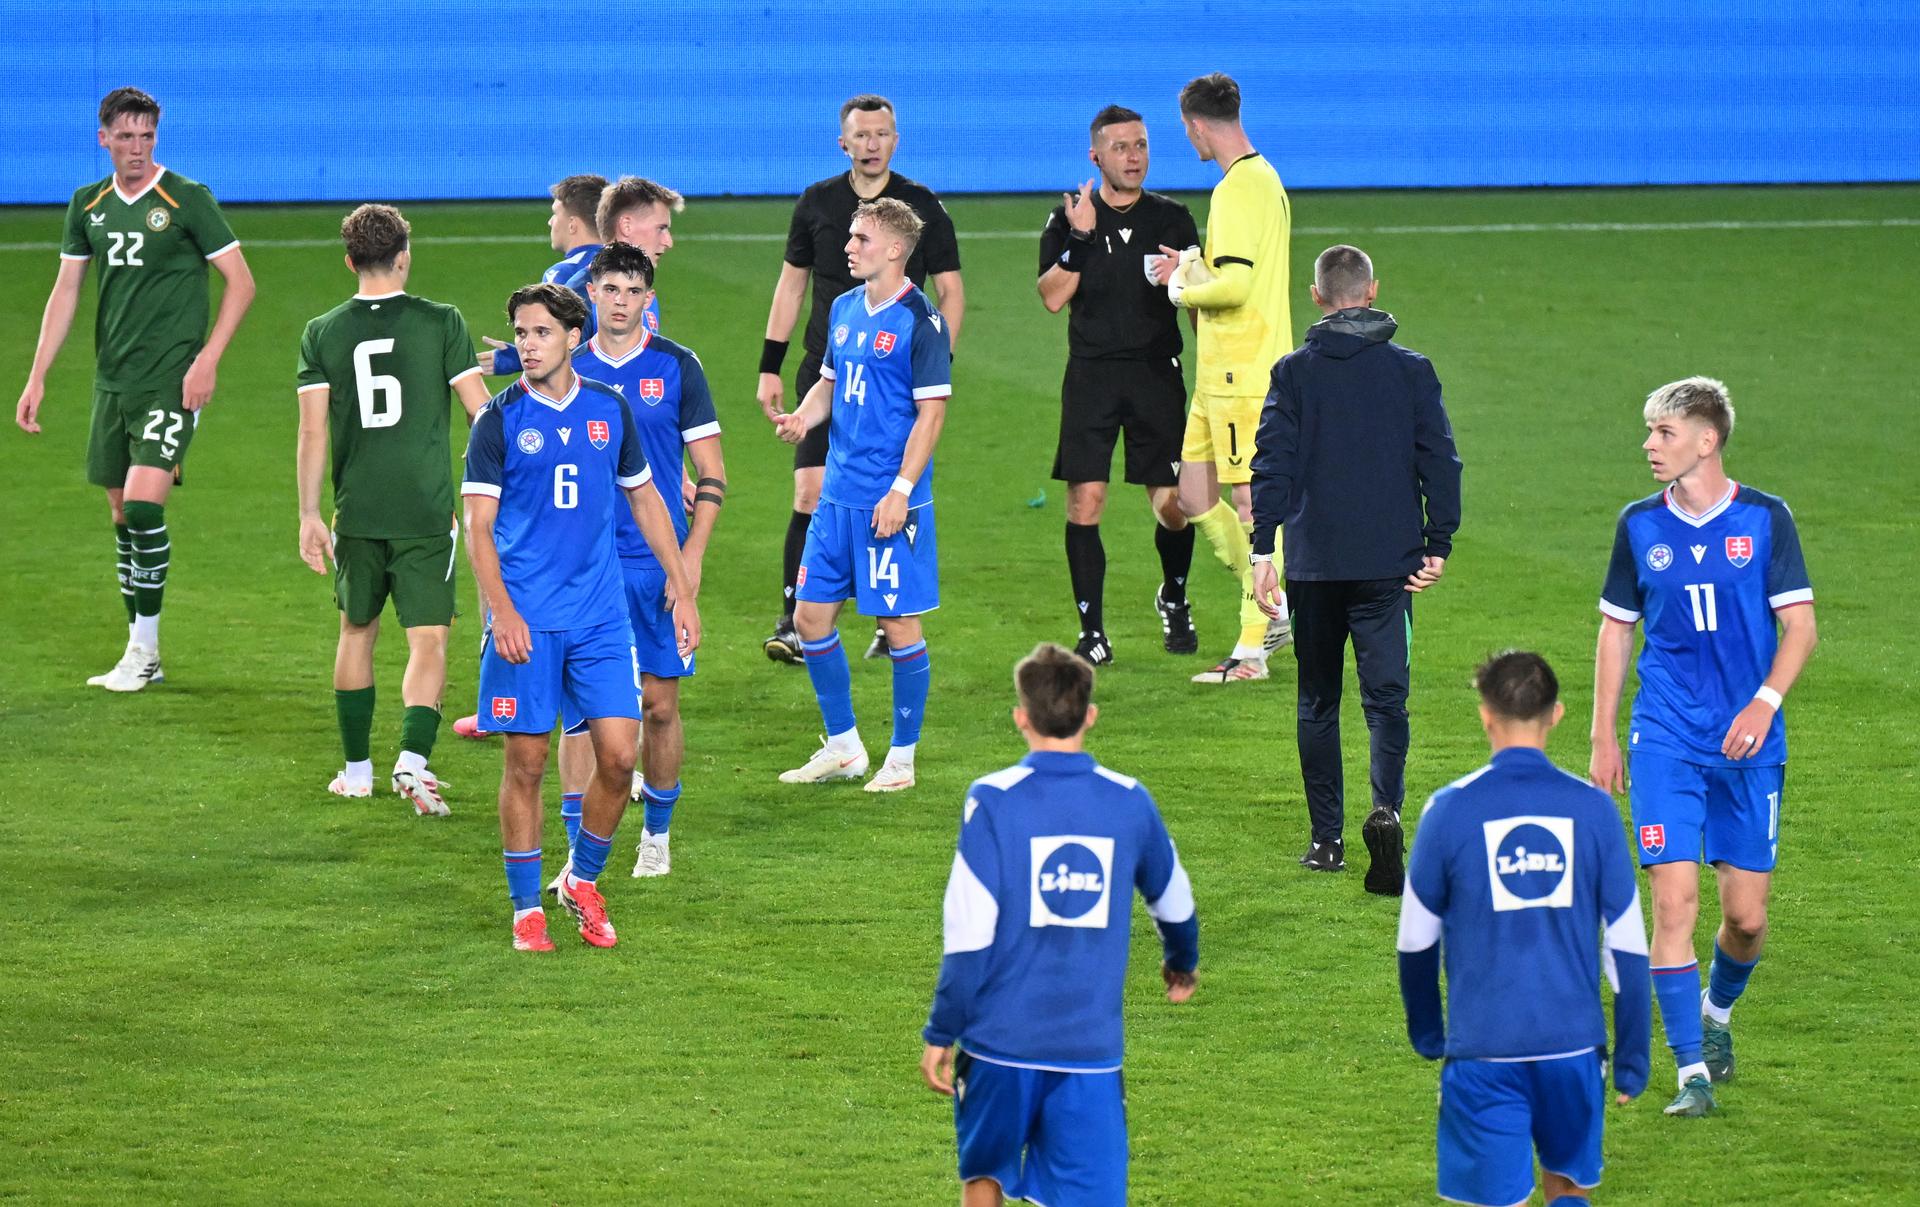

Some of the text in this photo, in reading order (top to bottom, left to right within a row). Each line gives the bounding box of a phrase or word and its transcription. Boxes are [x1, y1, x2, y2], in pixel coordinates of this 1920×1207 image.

[107, 231, 144, 266] 22
[353, 338, 402, 428] 6
[844, 361, 866, 406] 14
[142, 409, 183, 448] 22
[1227, 422, 1237, 456] 1
[554, 464, 578, 509] 6
[867, 547, 899, 589] 14
[1684, 583, 1717, 632] 11
